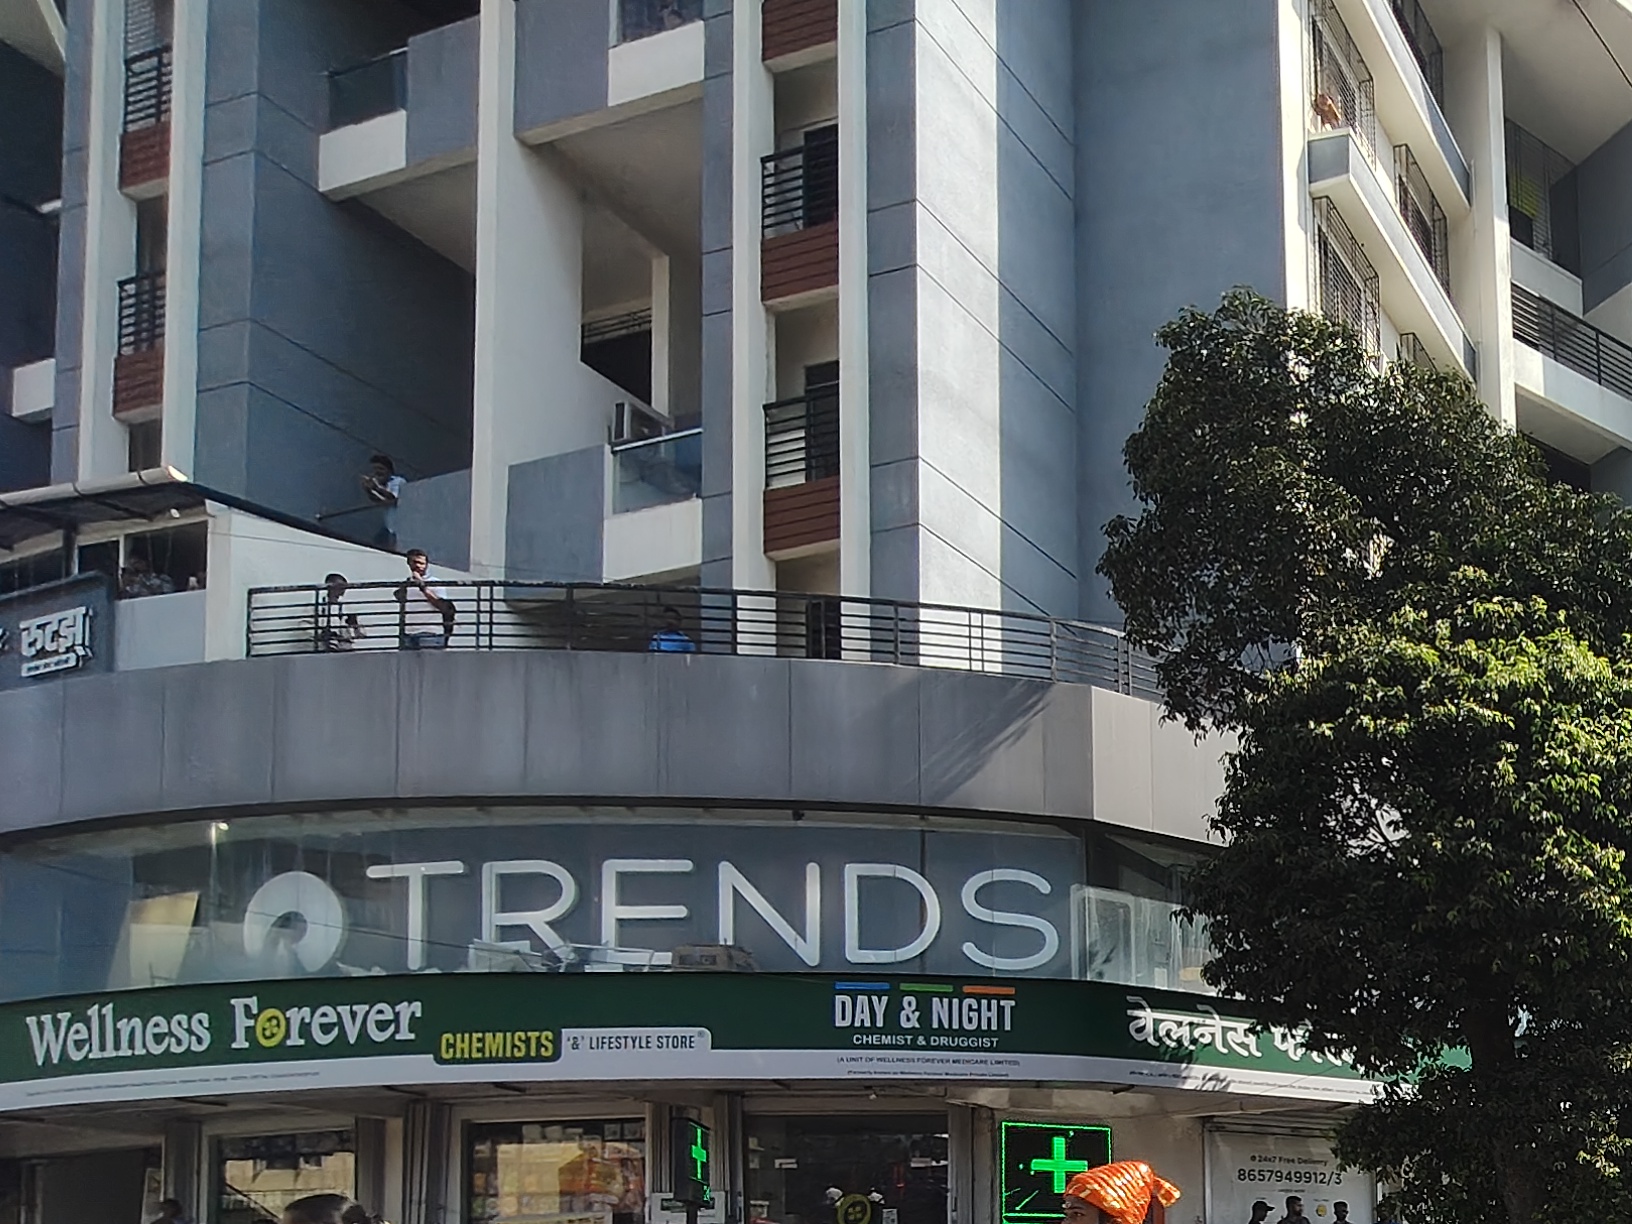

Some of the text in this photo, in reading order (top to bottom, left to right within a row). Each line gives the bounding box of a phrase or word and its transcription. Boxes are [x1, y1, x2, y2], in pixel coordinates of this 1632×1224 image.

[365, 857, 1061, 970] TRENDS
[834, 995, 1016, 1031] DAY & NIGHT
[1126, 996, 1263, 1058] वेलनेस
[26, 996, 422, 1066] Wellness Forever
[440, 1031, 554, 1059] CHEMISTS
[589, 1035, 653, 1050] LIFESTYLE
[656, 1035, 696, 1050] STORE
[853, 1034, 999, 1048] CHEMIST & DRUGGIST
[1257, 1154, 1277, 1163] 24x7
[1279, 1156, 1296, 1164] Free
[1237, 1168, 1343, 1186] 8657949912/3
